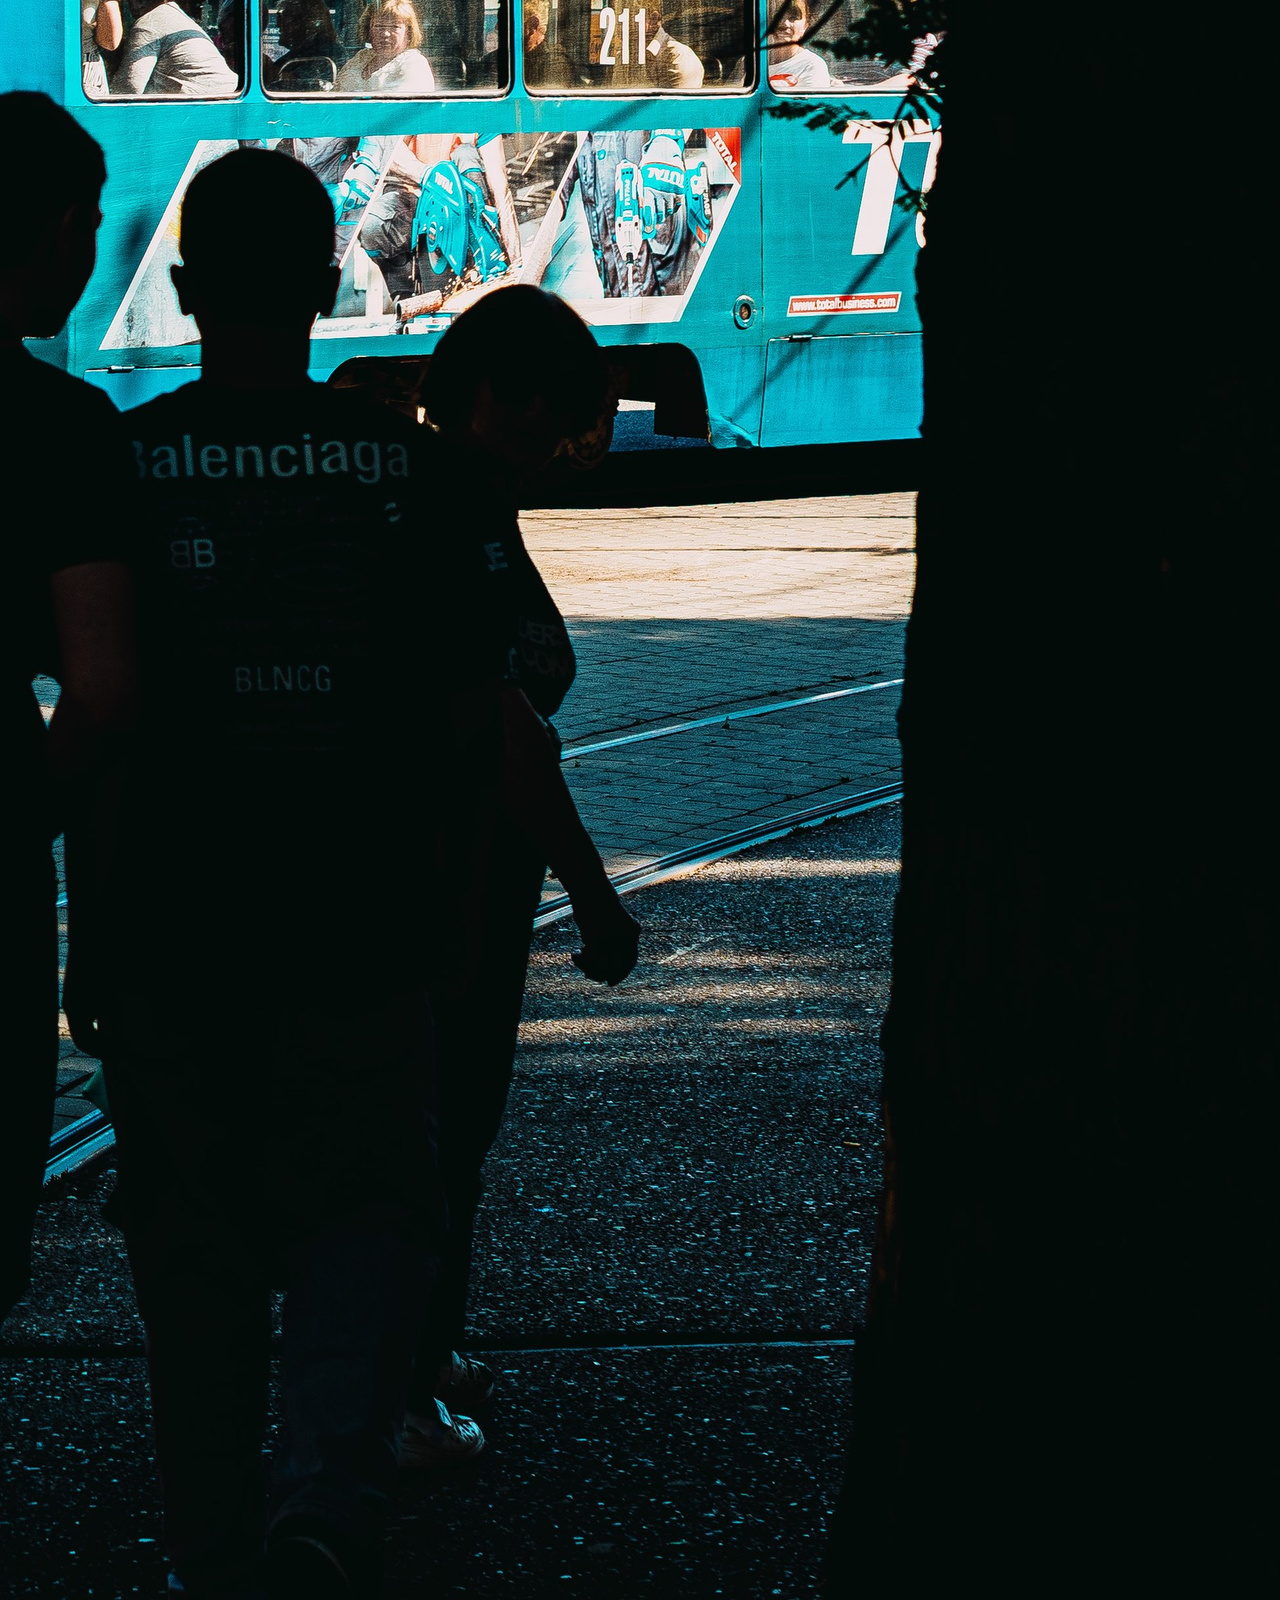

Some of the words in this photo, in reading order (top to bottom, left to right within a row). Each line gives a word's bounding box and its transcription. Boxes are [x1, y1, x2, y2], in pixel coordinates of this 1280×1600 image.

[600, 7, 646, 65] 211
[710, 131, 740, 173] TOTAL
[792, 296, 896, 312] www.totalbusiness.com
[233, 664, 333, 694] BLNCG
